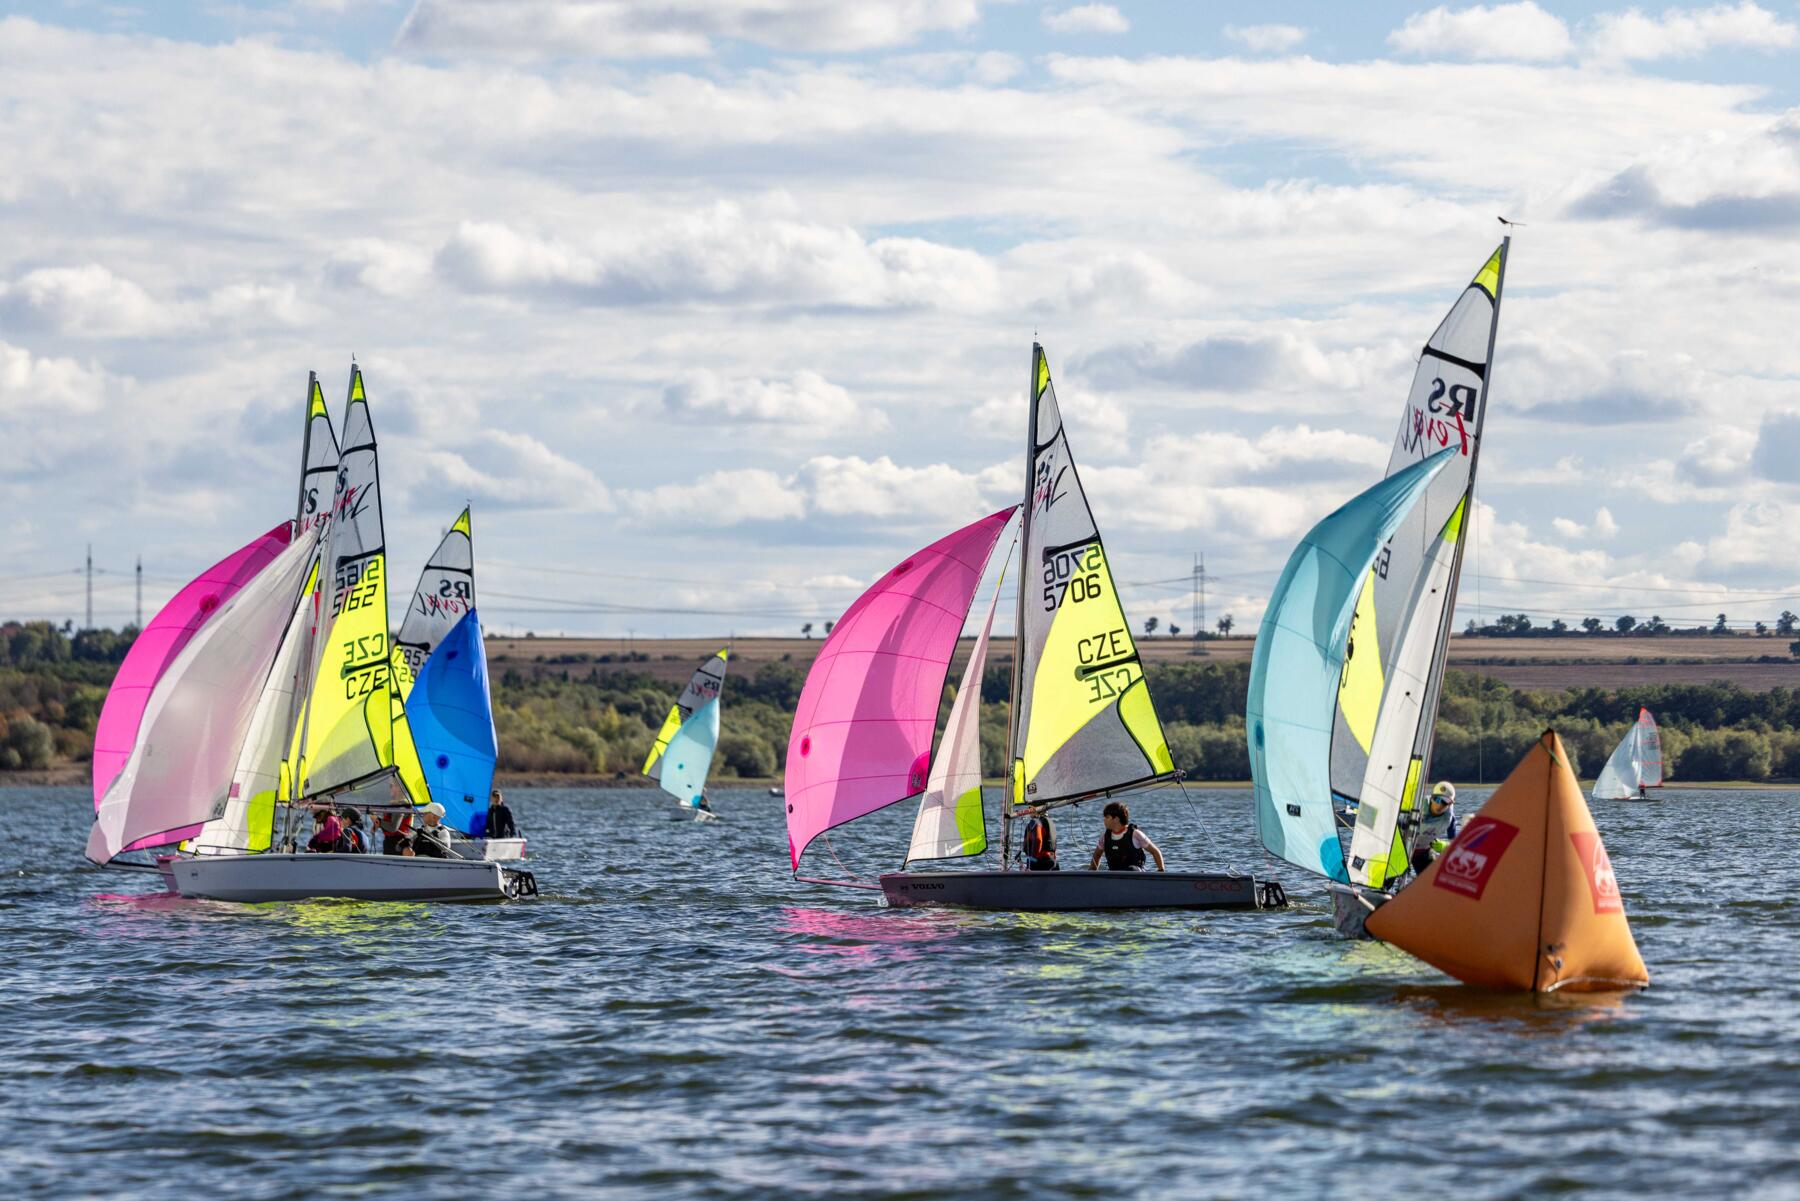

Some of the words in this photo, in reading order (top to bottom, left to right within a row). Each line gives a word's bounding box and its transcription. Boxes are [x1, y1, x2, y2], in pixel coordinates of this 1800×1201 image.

[331, 583, 378, 619] 5162
[1043, 573, 1101, 613] 5706
[1077, 628, 1128, 665] CZE
[346, 667, 387, 700] CZE
